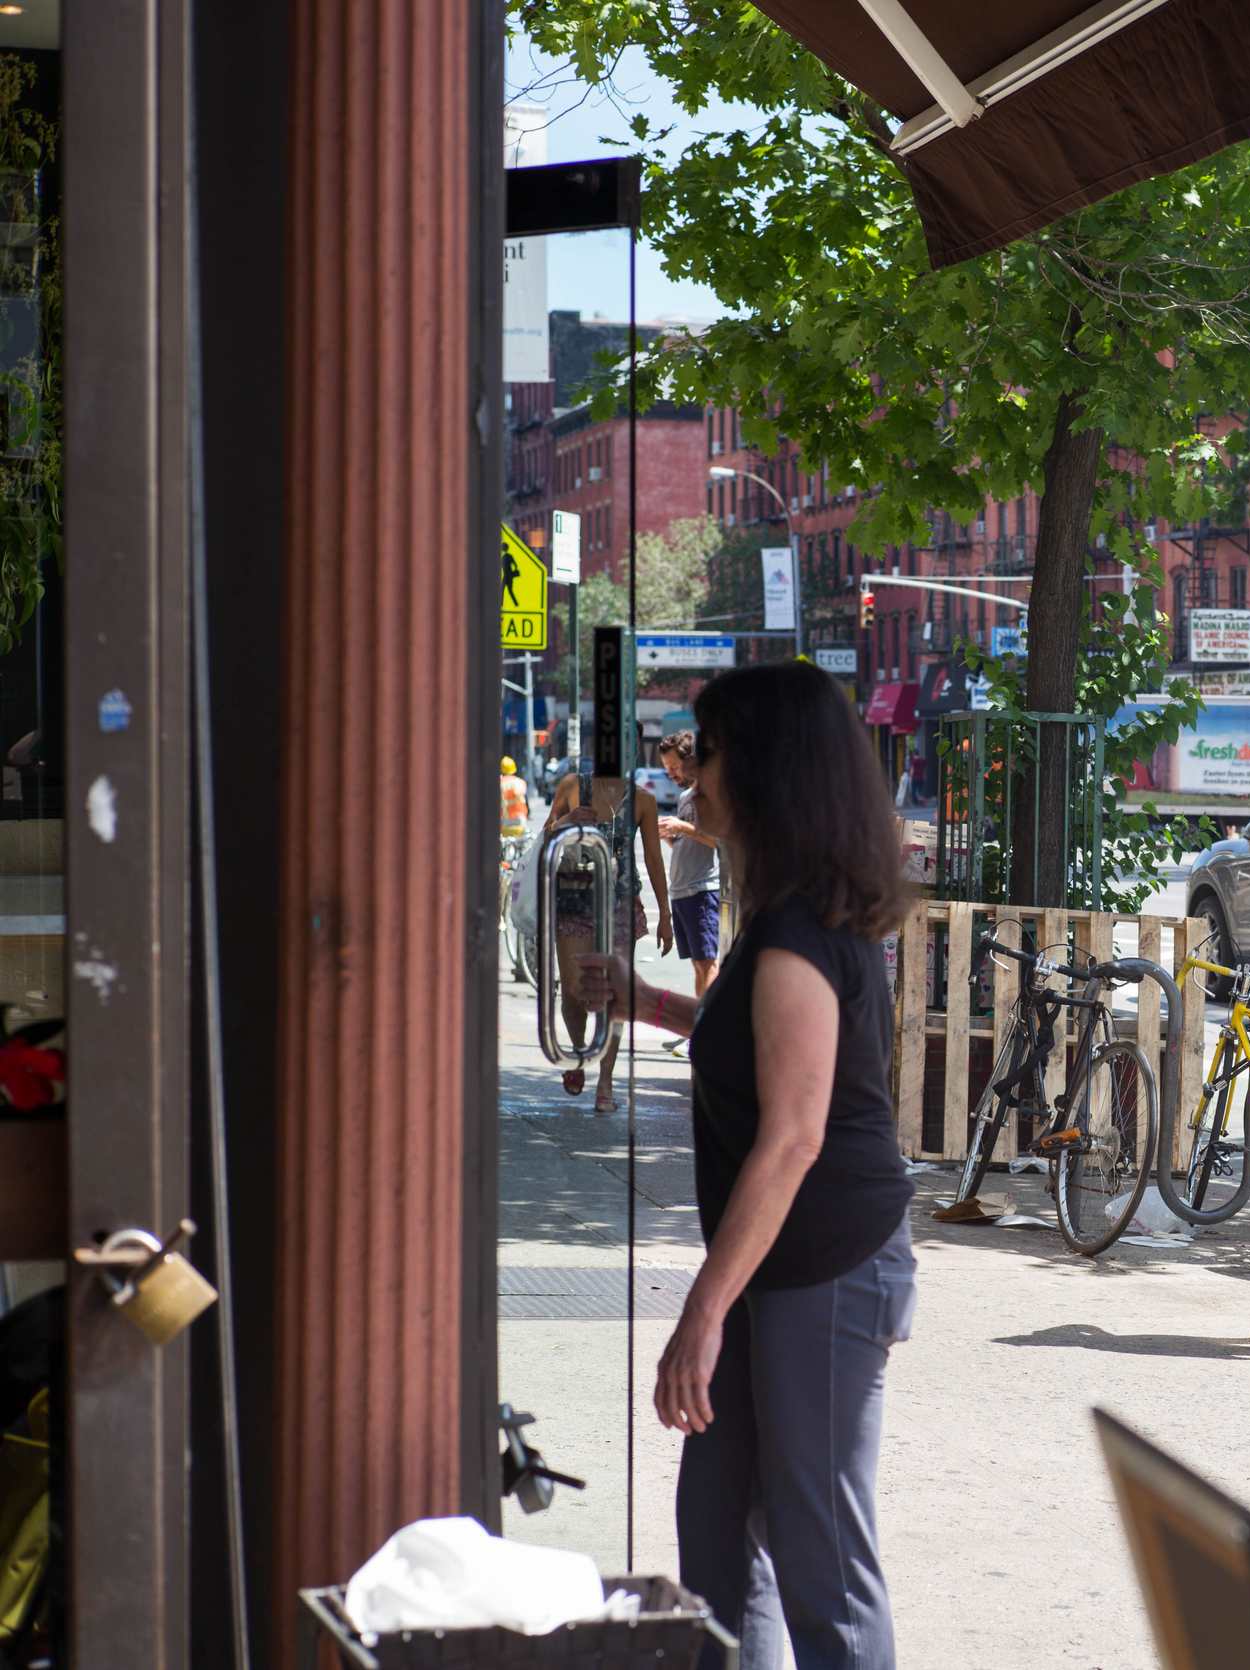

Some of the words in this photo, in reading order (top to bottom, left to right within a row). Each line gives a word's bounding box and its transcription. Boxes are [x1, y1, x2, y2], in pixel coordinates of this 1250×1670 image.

[504, 242, 526, 260] nt
[1193, 621, 1221, 630] MADINA
[1224, 622, 1250, 631] MASJID
[1193, 631, 1220, 640] ISLAMIC
[1223, 632, 1250, 640] COUNCIL
[1207, 641, 1237, 649] AMERICA
[819, 653, 854, 667] tree
[1227, 673, 1237, 684] OF
[600, 641, 616, 764] PUSH
